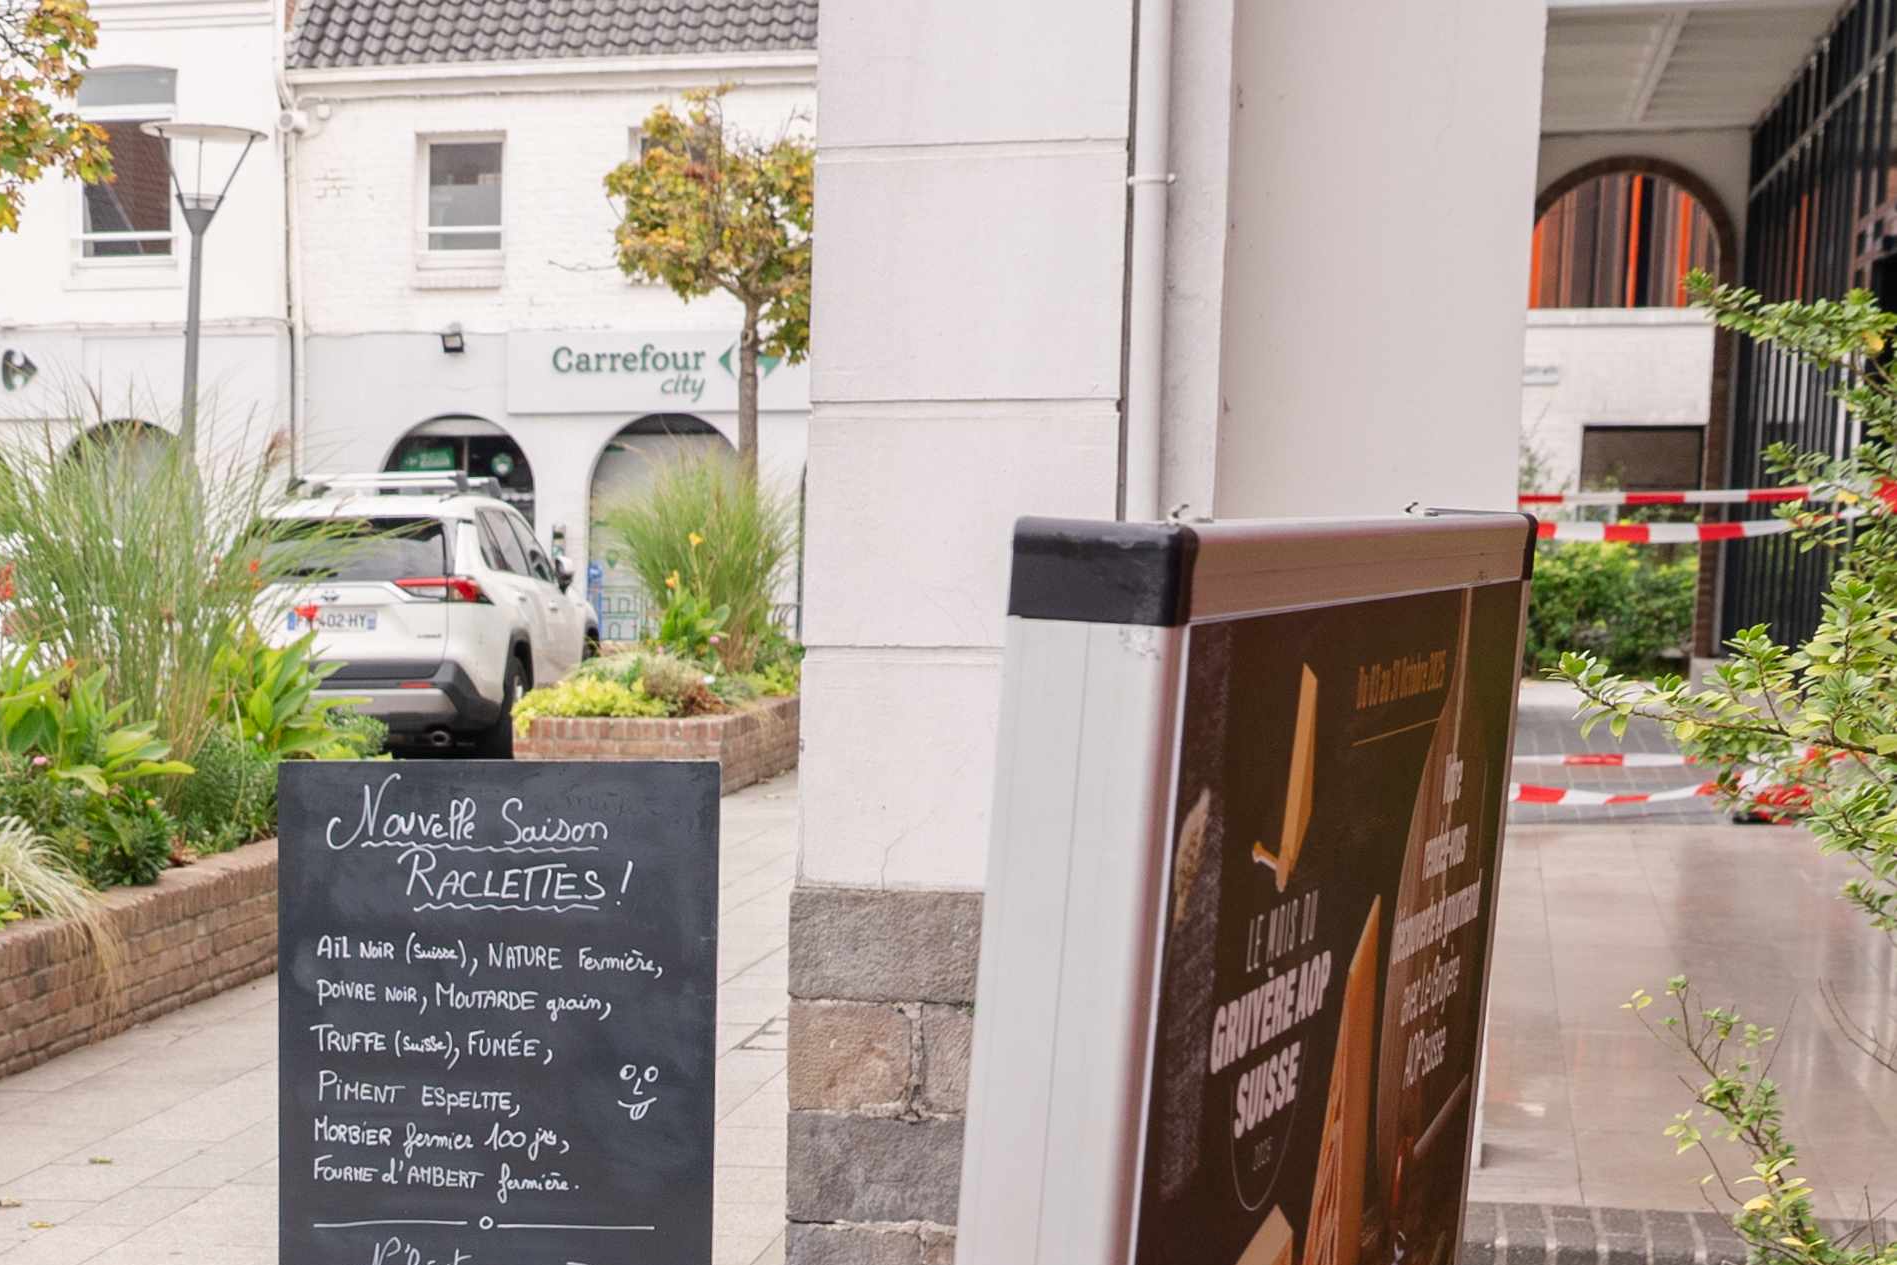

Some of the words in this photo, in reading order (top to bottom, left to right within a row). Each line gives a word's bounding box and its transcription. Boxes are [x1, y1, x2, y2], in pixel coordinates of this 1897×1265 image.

[552, 343, 705, 373] Carrefour
[661, 374, 705, 402] city
[326, 774, 475, 849] Nouvelle
[501, 798, 608, 845] Saison
[397, 847, 605, 900] RACLETTES
[1246, 914, 1265, 973] LE
[1266, 898, 1299, 962] MOIS
[1301, 889, 1319, 945] DU
[488, 942, 562, 971] NATURE
[435, 983, 539, 1010] MOUTARDE
[546, 995, 612, 1023] grain,
[1210, 966, 1297, 1075] GRUYÈRE
[1295, 950, 1332, 1024] AOP
[310, 1024, 387, 1052] TRUFFE
[1234, 1040, 1301, 1140] SUISSE
[403, 1122, 474, 1158] fermier
[484, 1122, 526, 1151] 100
[313, 1155, 379, 1183] FOURME
